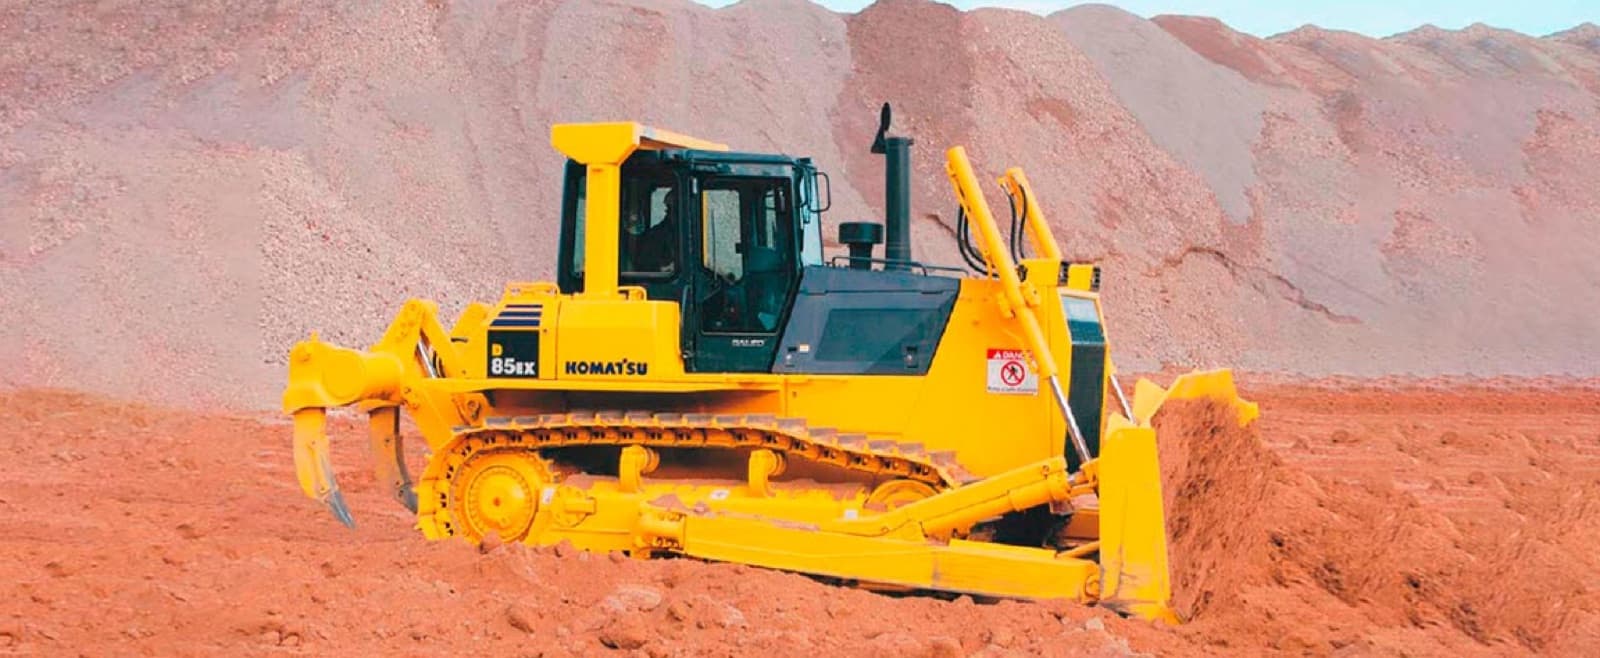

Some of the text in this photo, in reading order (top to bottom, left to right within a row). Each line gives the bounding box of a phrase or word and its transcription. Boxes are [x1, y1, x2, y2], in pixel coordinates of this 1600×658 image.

[491, 343, 503, 356] D
[491, 357, 535, 376] 85EX
[565, 358, 648, 375] KOMATSU
